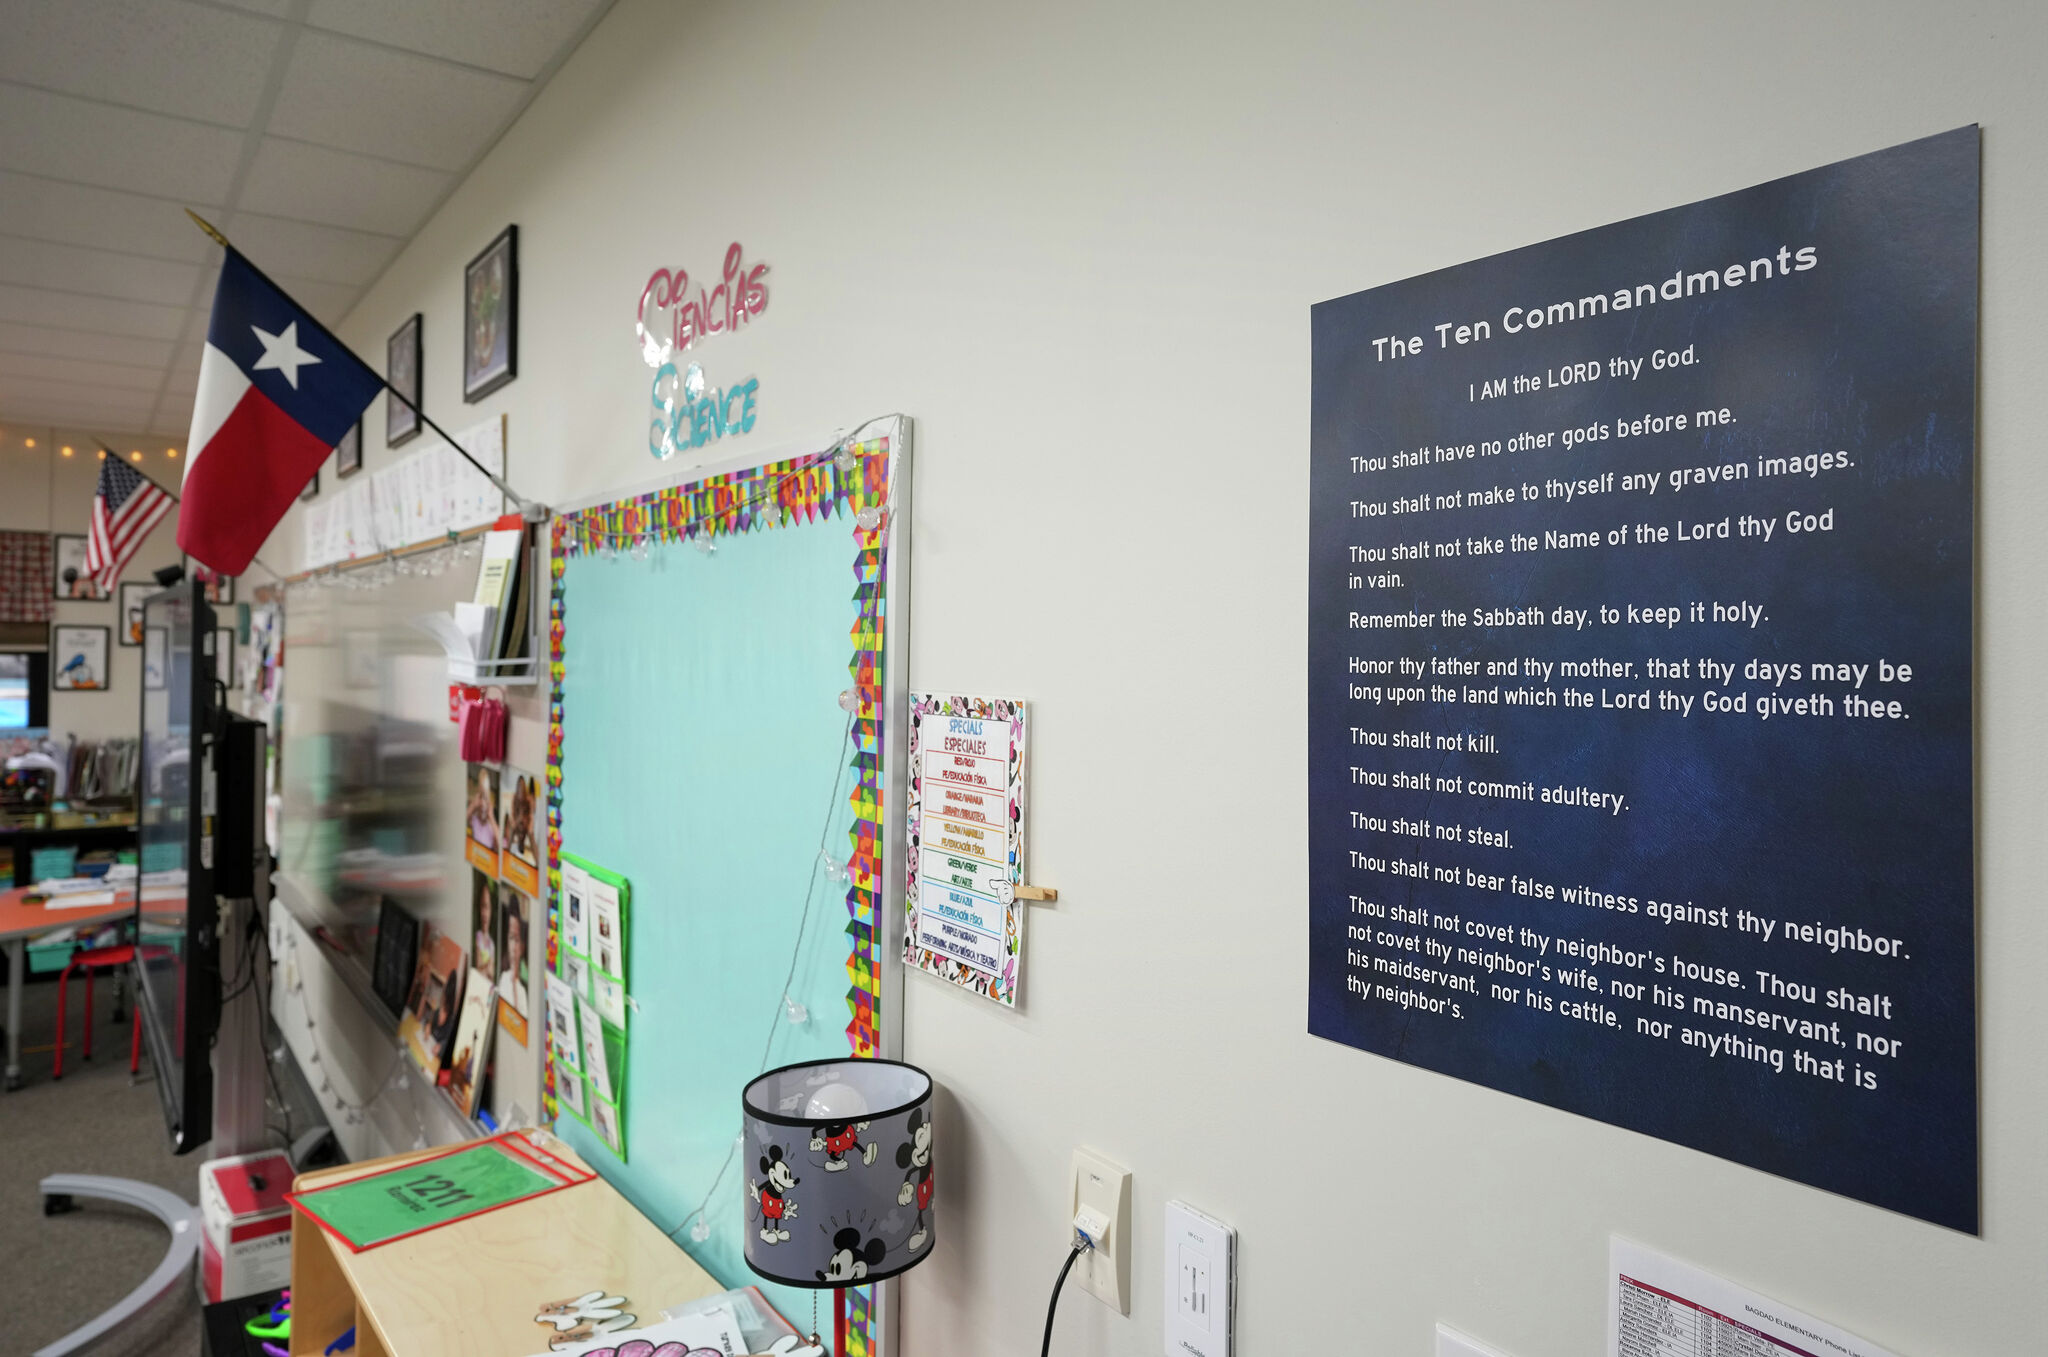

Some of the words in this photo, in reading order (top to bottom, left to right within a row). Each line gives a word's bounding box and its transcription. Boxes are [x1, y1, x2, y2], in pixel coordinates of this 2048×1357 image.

[1371, 335, 1424, 362] The
[1434, 320, 1491, 349] Ten
[1502, 245, 1818, 334] Commandments
[1469, 383, 1474, 403] I
[1480, 377, 1507, 401] AM
[1512, 374, 1542, 395] the
[1547, 360, 1601, 389] LORD
[1608, 356, 1644, 381] thy
[1651, 343, 1700, 370] God.
[1350, 455, 1387, 474] Thou
[1391, 446, 1430, 469] shalt
[1435, 444, 1476, 463] have
[1481, 440, 1502, 457] no
[1507, 431, 1555, 453] other
[1561, 421, 1610, 451] gods
[1617, 413, 1688, 438] before
[1696, 407, 1737, 428] me.
[1349, 500, 1387, 519] Thou
[1392, 493, 1431, 515] shalt
[1435, 489, 1462, 510] not
[1467, 485, 1516, 507] make
[1521, 481, 1539, 501] to
[1545, 471, 1614, 503] thyself
[1621, 472, 1661, 495] any
[1669, 462, 1749, 493] graven
[1758, 450, 1855, 479] images.
[1348, 545, 1386, 563] Thou
[1391, 540, 1430, 561] shalt
[1435, 538, 1462, 558] not
[1466, 535, 1505, 556] take
[1510, 532, 1539, 553] the
[1544, 530, 1601, 550] Name
[1607, 524, 1628, 546] of
[1634, 523, 1669, 544] the
[1677, 516, 1730, 541] Lord
[1737, 514, 1777, 543] thy
[1785, 507, 1834, 534] God
[1349, 572, 1363, 590] in
[1367, 570, 1405, 589] vain.
[1349, 610, 1436, 629] Remember
[1440, 609, 1467, 628] the
[1472, 606, 1545, 627] Sabbath
[1551, 605, 1593, 631] day,
[1599, 604, 1620, 625] to
[1627, 603, 1681, 630] keep
[1690, 601, 1705, 623] it
[1713, 600, 1769, 629] holy.
[1349, 656, 1395, 675] Honor
[1399, 656, 1426, 681] thy
[1430, 656, 1481, 676] father
[1486, 657, 1518, 676] and
[1523, 657, 1554, 683] thy
[1560, 657, 1639, 681] mother,
[1646, 657, 1691, 679] that
[1697, 657, 1736, 686] thy
[1744, 658, 1802, 688] days
[1811, 663, 1869, 689] may
[1879, 658, 1913, 683] be
[949, 718, 984, 735] SPECIALS
[1349, 682, 1382, 706] long
[1387, 687, 1425, 706] upon
[1430, 684, 1457, 703] the
[1463, 684, 1499, 705] land
[1504, 686, 1557, 707] which
[1563, 687, 1594, 708] the
[1601, 688, 1650, 710] Lord
[1658, 689, 1695, 718] thy
[1703, 690, 1747, 713] God
[1756, 691, 1834, 721] giveth
[1843, 694, 1910, 719] thee.
[944, 737, 986, 755] ESPECIALES
[1349, 727, 1387, 747] Thou
[1392, 730, 1431, 750] shalt
[1436, 733, 1463, 752] not
[1468, 733, 1499, 754] kill.
[1349, 766, 1387, 787] Thou
[1392, 770, 1431, 791] shalt
[1436, 775, 1463, 794] not
[1467, 780, 1535, 801] commit
[1540, 784, 1630, 816] adultery.
[1349, 811, 1387, 833] Thou
[1391, 816, 1431, 838] shalt
[1435, 823, 1462, 843] not
[1467, 826, 1514, 849] steal.
[1349, 850, 1386, 873] Thou
[1390, 857, 1430, 880] shalt
[1434, 866, 1461, 885] not
[1466, 868, 1506, 892] bear
[1510, 874, 1555, 900] false
[1561, 884, 1639, 914] witness
[1646, 900, 1729, 929] against
[1736, 909, 1777, 943] thy
[1785, 921, 1910, 960] neighbor.
[1348, 895, 1385, 919] Thou
[1390, 904, 1429, 927] shalt
[1433, 914, 1460, 933] not
[1465, 921, 1514, 944] covet
[1519, 927, 1550, 956] thy
[1556, 937, 1666, 973] neighbor's
[1673, 955, 1746, 990] house.
[1755, 970, 1816, 1004] Thou
[1825, 987, 1892, 1020] shalt
[1346, 974, 1372, 1001] thy
[1376, 984, 1465, 1020] neighbor's.
[1348, 925, 1372, 943] not
[1376, 931, 1421, 953] covet
[1425, 937, 1453, 965] thy
[1457, 947, 1551, 981] neighbor's
[1557, 967, 1604, 995] wife,
[1611, 980, 1646, 1001] nor
[1653, 984, 1685, 1010] his
[1693, 996, 1846, 1049] manservant,
[1856, 1032, 1903, 1058] nor
[1347, 947, 1369, 969] his
[1374, 957, 1480, 997] maidservant,
[1491, 984, 1521, 1004] nor
[1526, 988, 1553, 1012] his
[1559, 1000, 1622, 1031] cattle,
[1637, 1017, 1673, 1040] nor
[1680, 1027, 1784, 1074] anything
[1793, 1049, 1845, 1083] that
[1855, 1062, 1877, 1090] is
[404, 1174, 475, 1209] 1211
[1745, 1304, 1774, 1322] BAGDAD
[1776, 1317, 1822, 1343] ELEMENTARY
[1825, 1339, 1847, 1354] Phone
